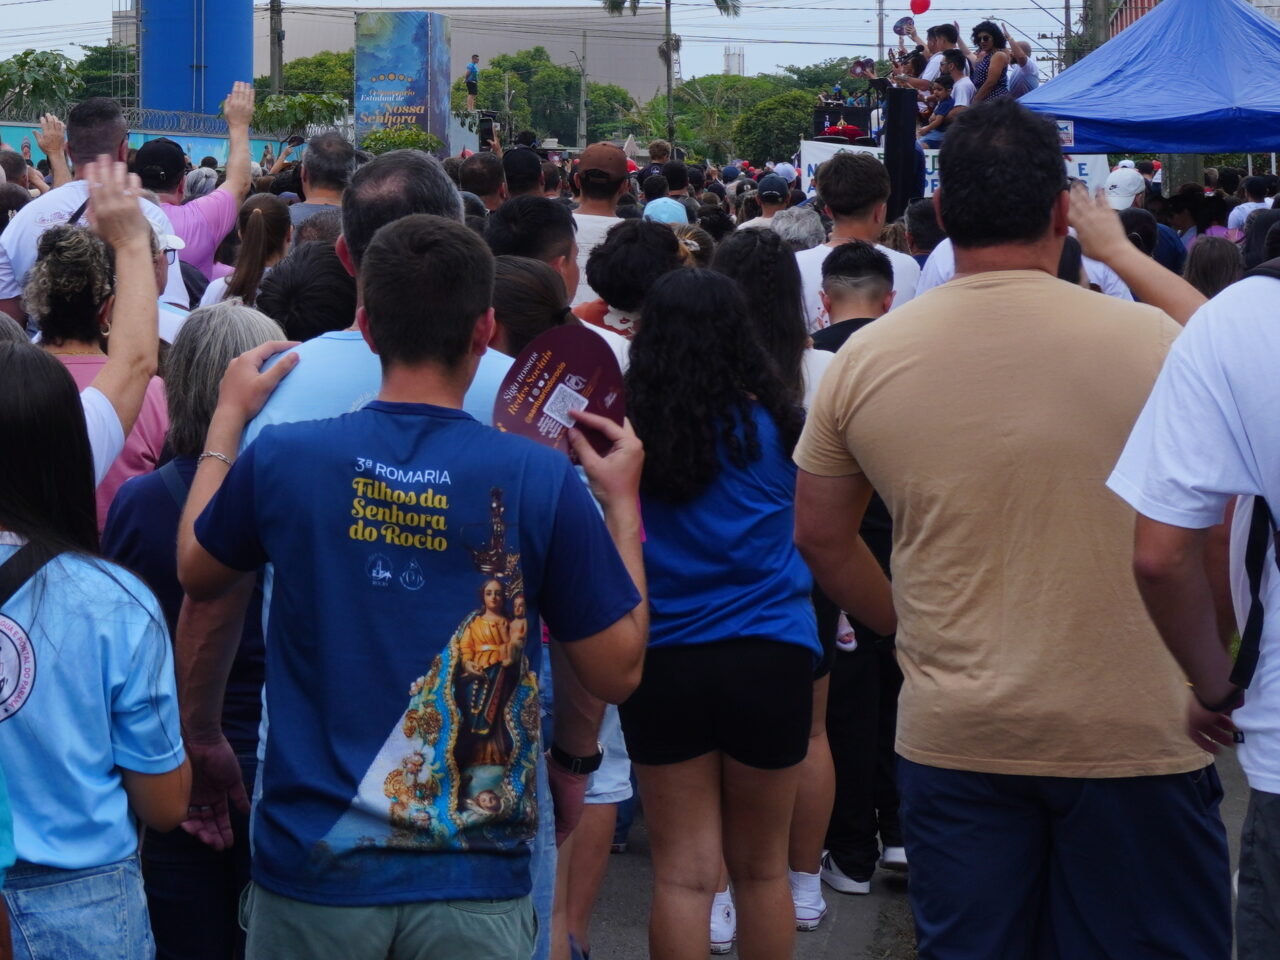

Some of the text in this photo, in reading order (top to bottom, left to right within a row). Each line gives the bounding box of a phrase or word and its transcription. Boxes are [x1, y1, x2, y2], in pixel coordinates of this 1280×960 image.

[360, 109, 417, 128] Senhora
[381, 103, 425, 114] Nossa
[503, 351, 539, 403] Siga nossas
[508, 385, 530, 415] Redes
[526, 350, 553, 385] Sociais
[375, 462, 452, 485] ROMARIA
[352, 477, 449, 509] Filhos da
[351, 497, 448, 531] Senhora
[349, 520, 448, 551] do Rocio
[17, 636, 31, 665] PONTAL
[24, 667, 31, 680] DO
